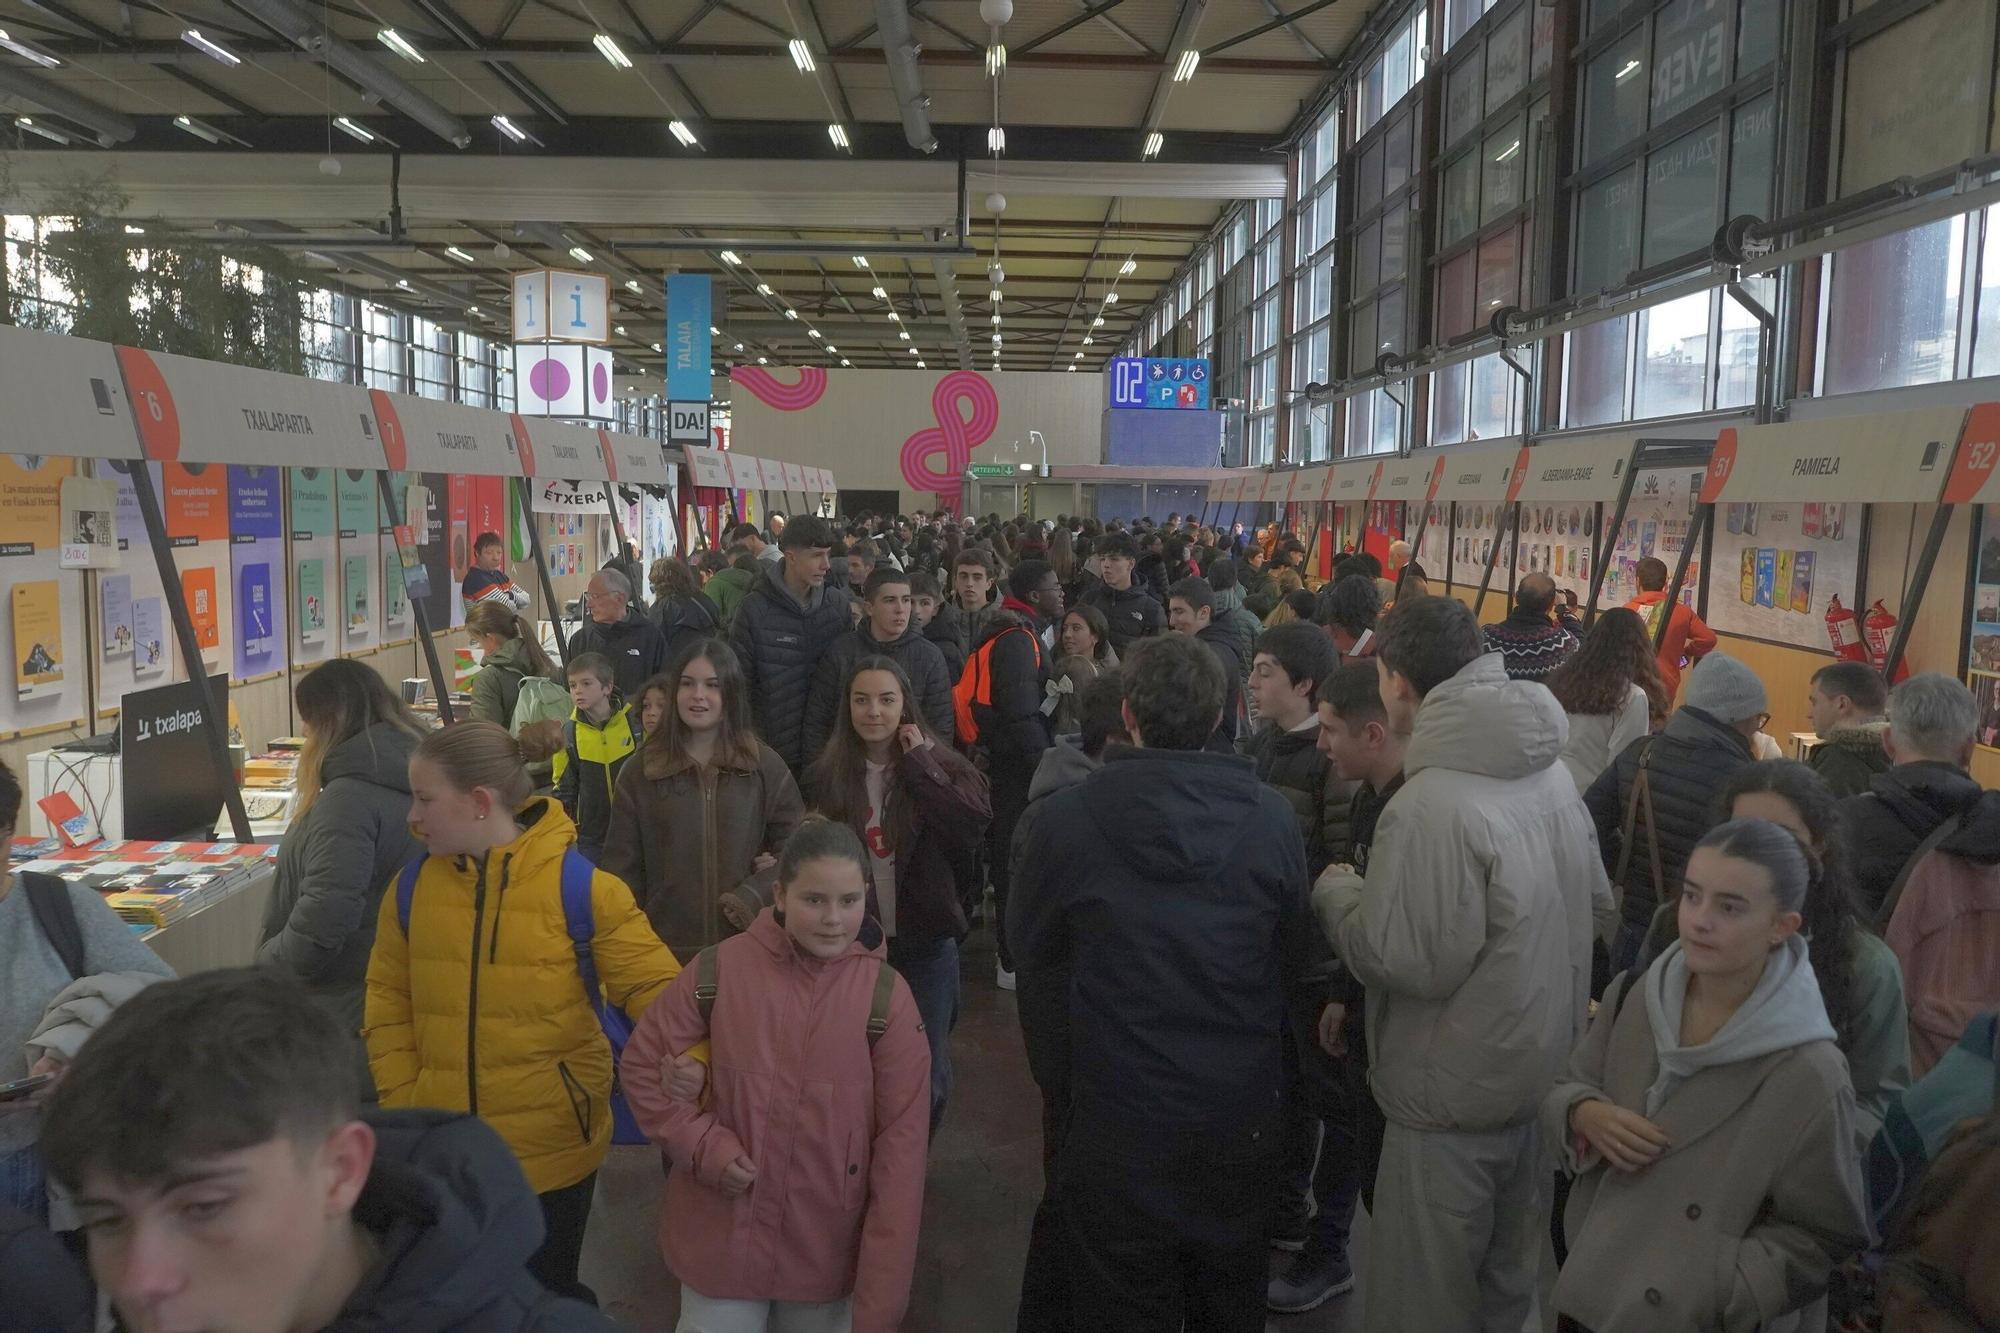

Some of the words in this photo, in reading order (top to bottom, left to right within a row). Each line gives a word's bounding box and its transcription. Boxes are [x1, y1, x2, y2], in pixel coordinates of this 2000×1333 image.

[677, 320, 691, 370] TALAIA
[1116, 361, 1143, 403] 02
[147, 391, 163, 422] 6
[241, 408, 314, 435] TXALAPARTA
[675, 412, 704, 430] DA!
[437, 432, 479, 451] TXALAPARTA
[1714, 458, 1730, 477] 51
[1792, 456, 1840, 477] PAMIELA
[1968, 441, 1996, 470] 52
[973, 466, 1001, 474] IRTEERA
[544, 489, 607, 505] ETXERA
[155, 708, 203, 736] txalapa
